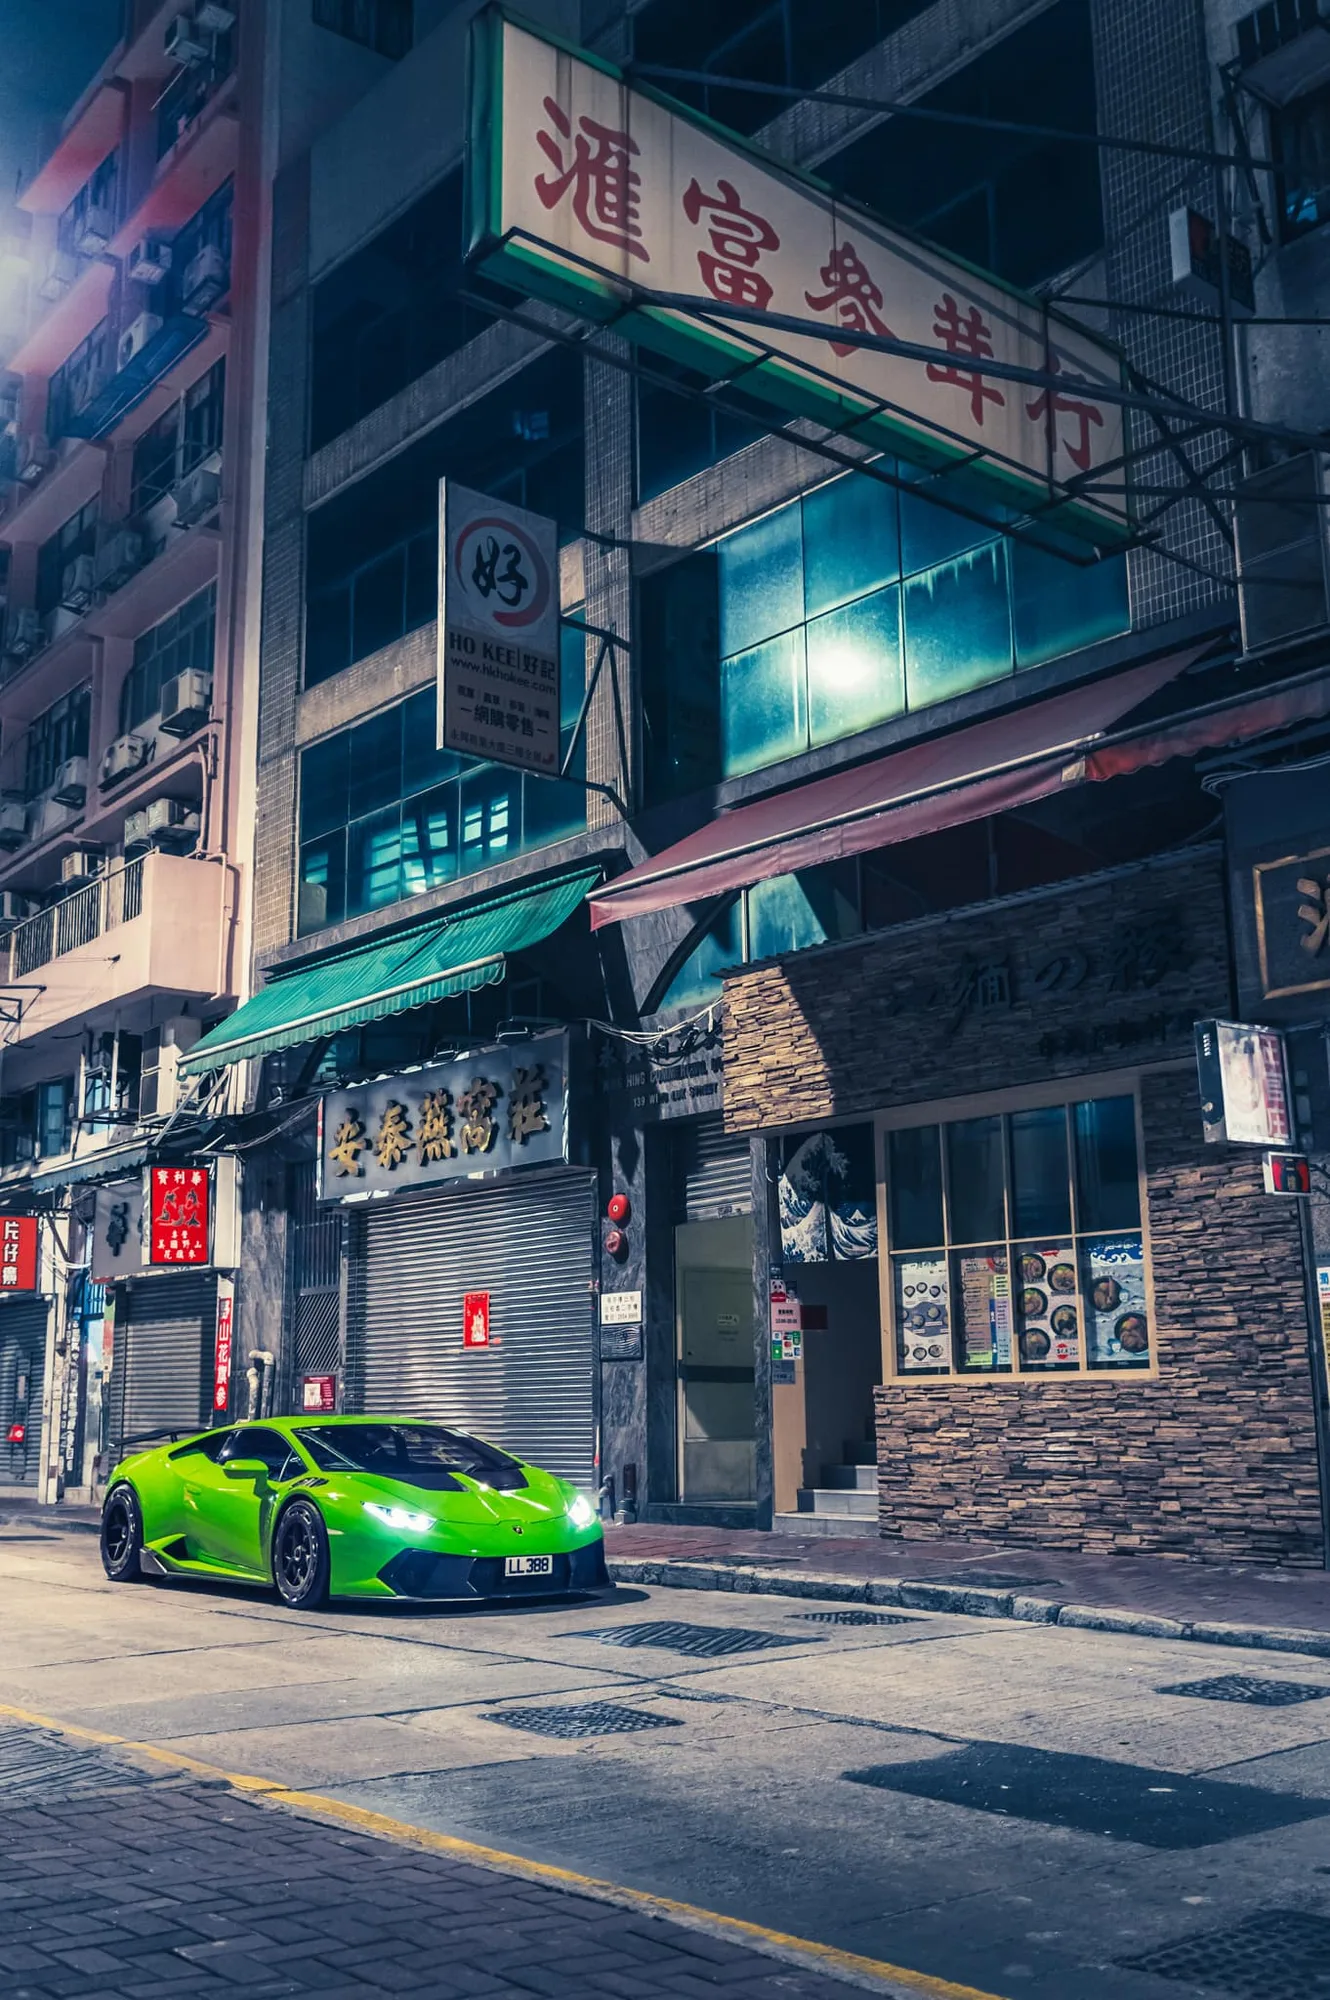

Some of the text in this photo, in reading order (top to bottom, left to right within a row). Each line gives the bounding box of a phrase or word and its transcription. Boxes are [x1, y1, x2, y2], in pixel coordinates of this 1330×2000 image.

[472, 535, 528, 606] 好
[449, 632, 516, 668] HO KEE
[523, 653, 556, 681] 好記
[450, 656, 557, 695] www.hkhokee.com
[509, 1557, 549, 1574] LL 388
